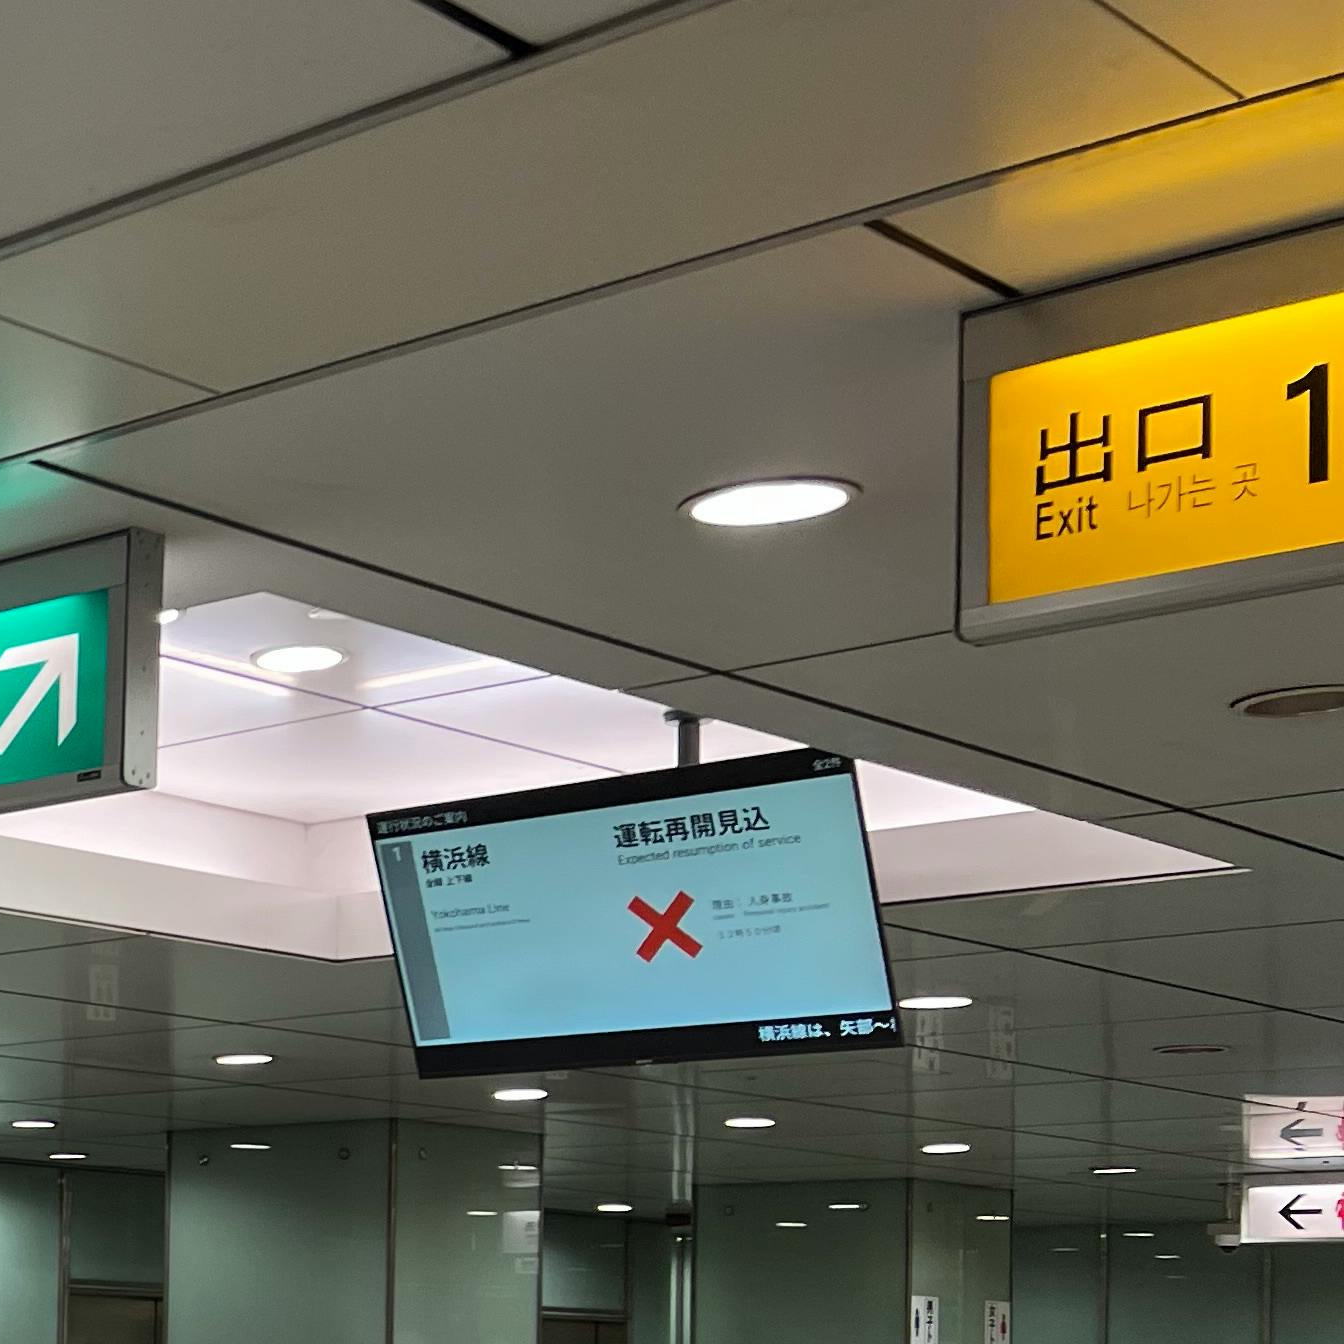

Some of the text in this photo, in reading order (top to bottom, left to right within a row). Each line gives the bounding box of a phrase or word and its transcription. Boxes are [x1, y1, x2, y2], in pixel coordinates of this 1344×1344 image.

[1035, 362, 1329, 497] 出口 1
[1127, 462, 1261, 519] 나가는 곳
[1035, 496, 1099, 541] Exit
[613, 806, 770, 848] 運転再開見込
[421, 843, 490, 874] 横浜線
[618, 834, 802, 866] Expected resumption of service
